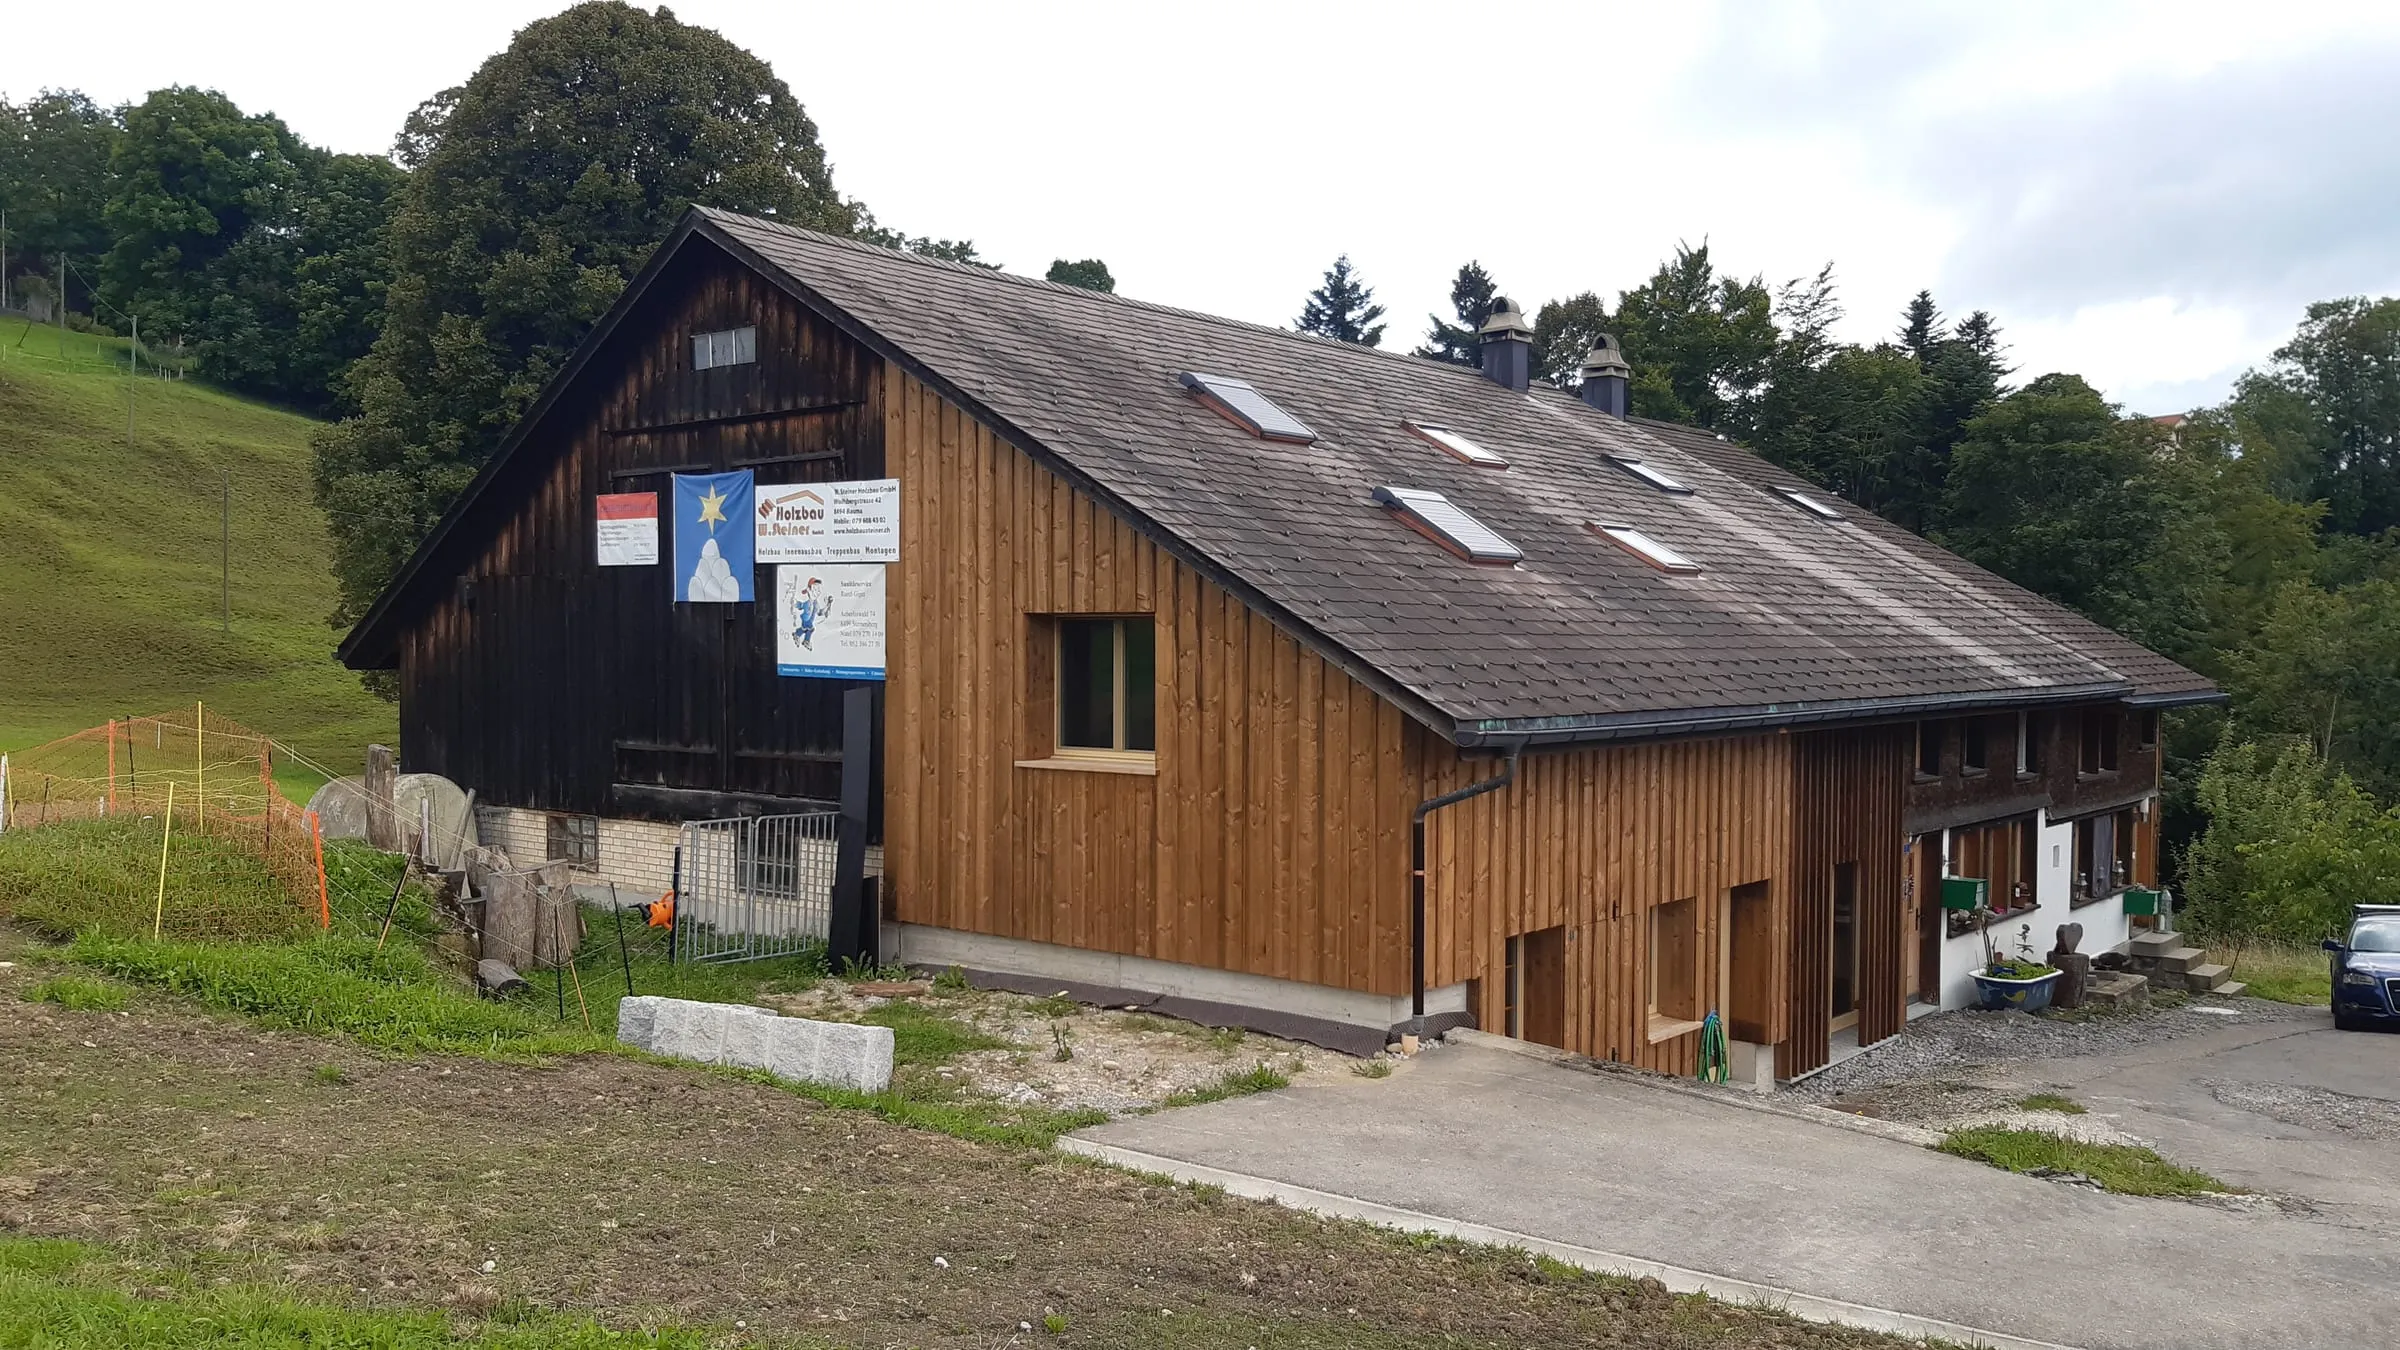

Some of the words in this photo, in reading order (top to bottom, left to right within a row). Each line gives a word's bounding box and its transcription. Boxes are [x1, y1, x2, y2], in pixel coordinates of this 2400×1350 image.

[880, 485, 897, 493] GmbH
[776, 505, 824, 521] Holzbau
[758, 522, 809, 536] W.Steiner
[833, 526, 891, 534] www.holzbausteiner.ch
[758, 548, 781, 556] Holzbau
[785, 547, 823, 556] Innenausbau
[827, 546, 861, 557] Treppenbau
[865, 545, 897, 557] Montagen
